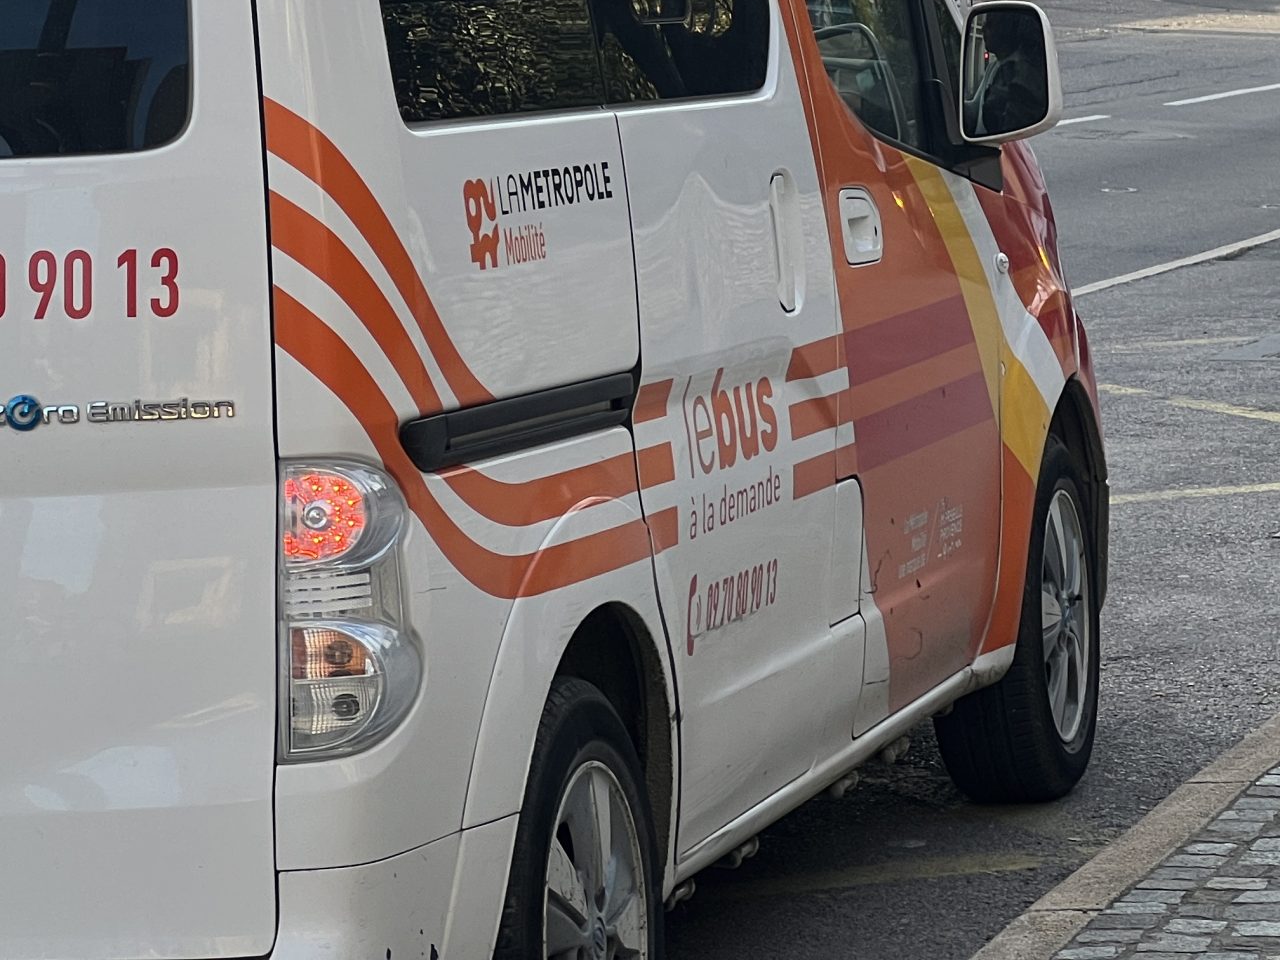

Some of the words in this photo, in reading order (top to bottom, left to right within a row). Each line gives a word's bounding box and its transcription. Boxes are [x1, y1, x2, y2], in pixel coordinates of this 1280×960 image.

[504, 222, 547, 266] Mobilité
[28, 249, 93, 320] 90
[117, 248, 180, 318] 13
[87, 398, 235, 423] Emission
[690, 496, 698, 540] à
[702, 493, 715, 534] la
[720, 465, 781, 526] demande
[706, 581, 720, 631] 09
[720, 576, 734, 626] 70
[736, 569, 749, 616] 80
[750, 563, 763, 613] 90
[766, 558, 778, 607] 13
